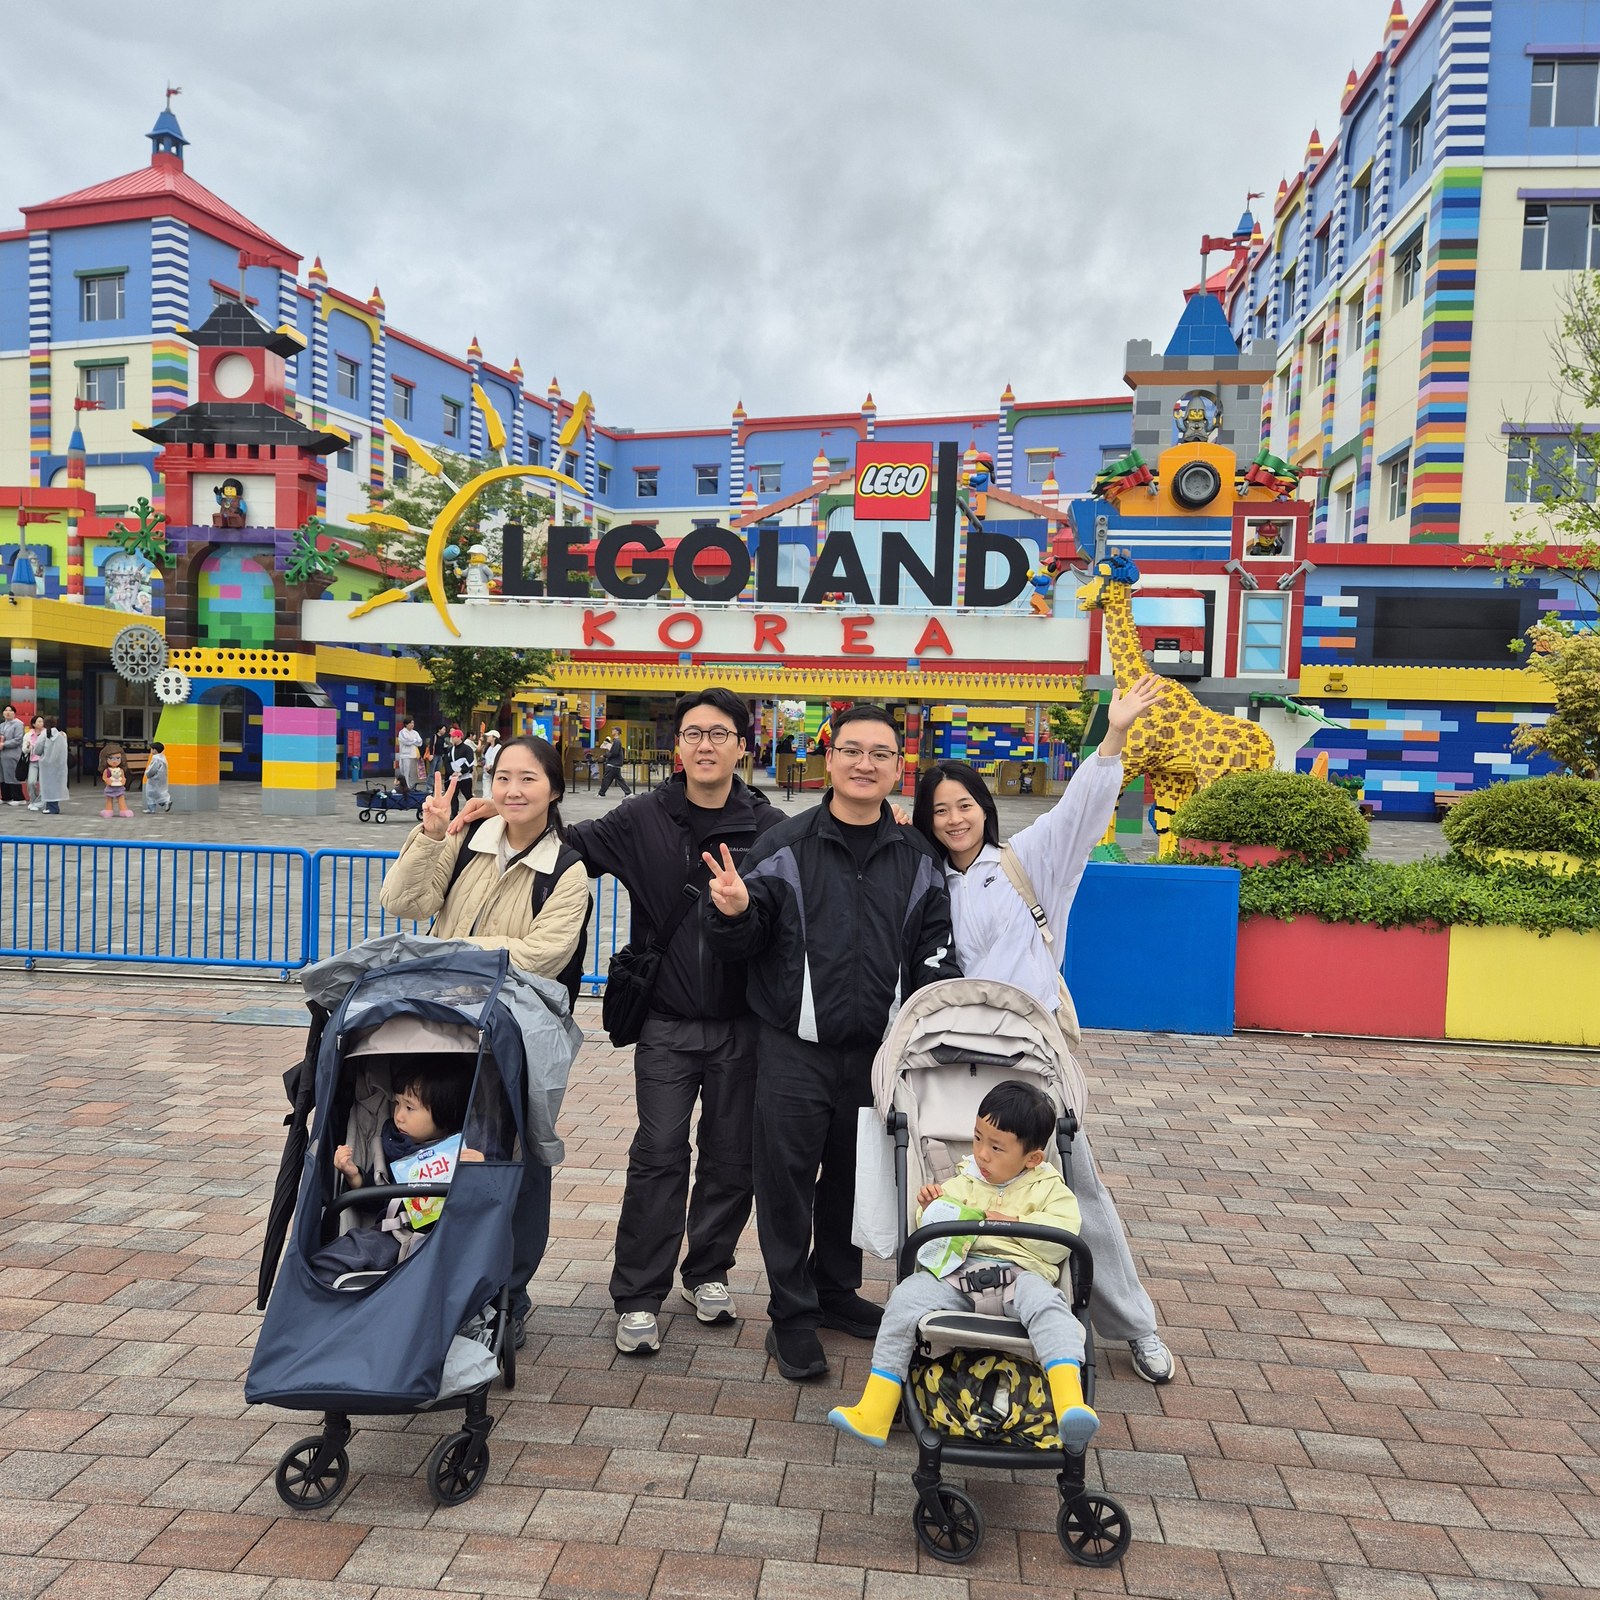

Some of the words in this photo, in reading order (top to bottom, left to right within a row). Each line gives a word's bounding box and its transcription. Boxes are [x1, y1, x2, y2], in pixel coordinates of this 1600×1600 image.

[859, 464, 930, 498] LEGO
[501, 442, 1030, 607] LEGOLAND
[583, 610, 953, 656] KOREA
[419, 1157, 450, 1179] 사과
